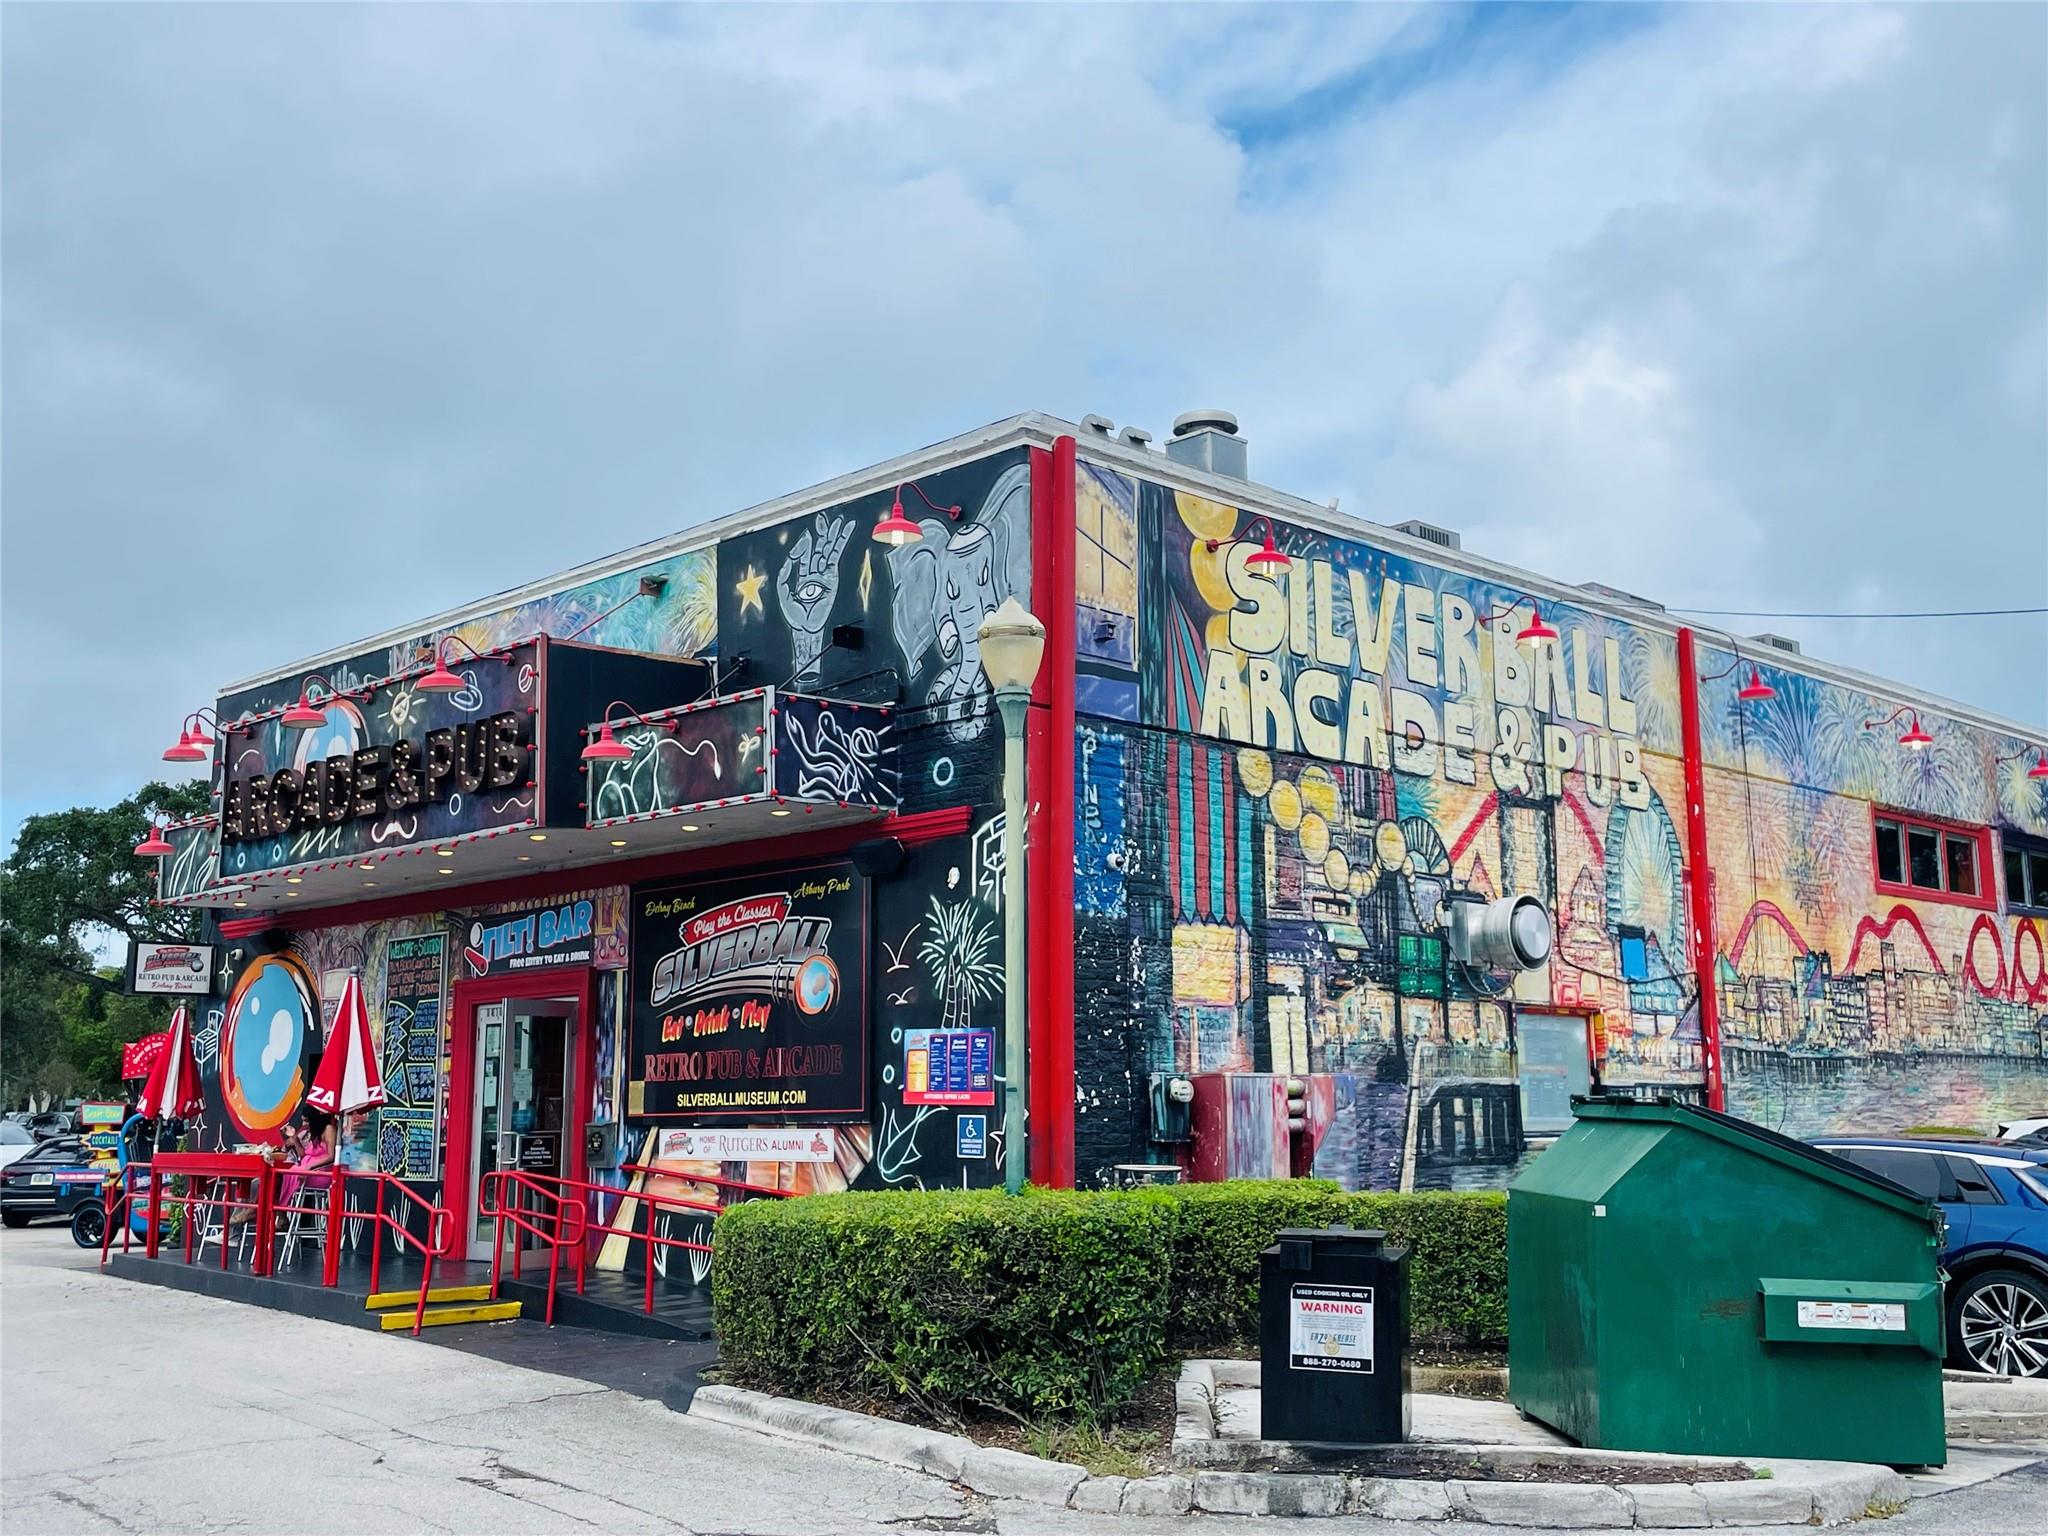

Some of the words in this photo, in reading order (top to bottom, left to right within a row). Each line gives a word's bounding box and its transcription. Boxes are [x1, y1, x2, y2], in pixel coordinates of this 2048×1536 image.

[1200, 650, 1478, 786] ARCADE
[1491, 707, 1535, 799] &
[1544, 724, 1651, 810] PUB
[221, 745, 388, 845] ARCADE
[426, 711, 530, 803] PUB
[793, 882, 826, 900] Asbury
[827, 877, 851, 894] Park
[645, 901, 672, 918] Delray
[673, 897, 696, 913] Beach
[694, 919, 716, 937] Play
[717, 913, 731, 927] the
[734, 902, 778, 922] Classics!
[482, 914, 536, 963] TILT!
[538, 900, 593, 948] BAR
[509, 958, 525, 968] FREE
[525, 956, 544, 967] ENTRY
[544, 955, 553, 964] TO
[553, 953, 565, 964] EAT
[565, 952, 570, 962] &
[570, 950, 590, 961] DRINK
[652, 918, 831, 1004] SILVERBALL
[182, 974, 208, 982] ARCADE
[662, 1015, 685, 1042] Eat
[693, 1004, 731, 1037] Drink
[740, 999, 771, 1033] Play
[644, 1052, 701, 1082] RETRO
[705, 1049, 743, 1080] PUB
[746, 1048, 760, 1080] &
[762, 1045, 844, 1079] ARCADE
[677, 1090, 806, 1108] SILVERBALLMUSEUM.COM
[699, 1135, 716, 1144] HOME
[719, 1135, 769, 1156] RUTGERS
[771, 1139, 804, 1151] ALUMNI
[1301, 1302, 1363, 1315] WARNING
[1303, 1357, 1361, 1369] 888-270-0680
